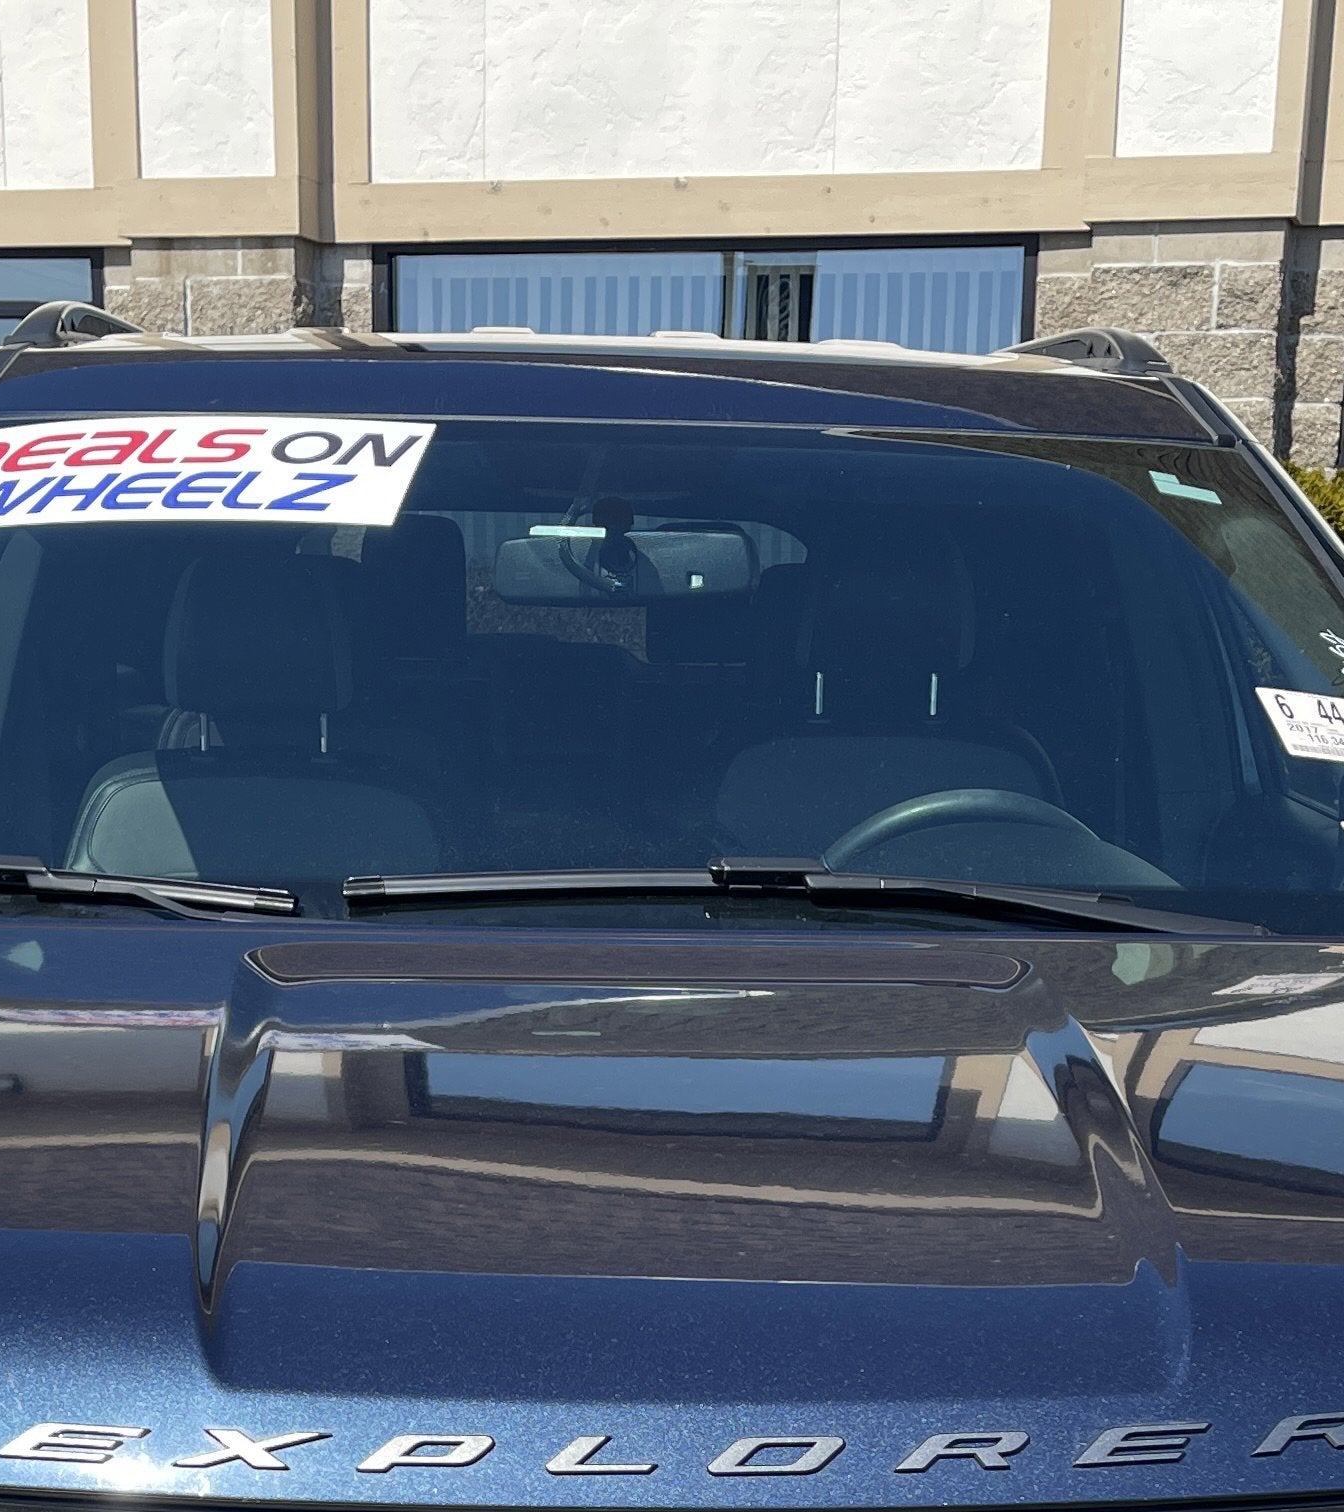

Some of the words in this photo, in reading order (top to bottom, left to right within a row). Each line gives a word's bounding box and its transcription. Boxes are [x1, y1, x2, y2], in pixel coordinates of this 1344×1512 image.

[271, 431, 423, 468] ON
[1274, 693, 1295, 720] 6
[1287, 722, 1319, 735] 2017
